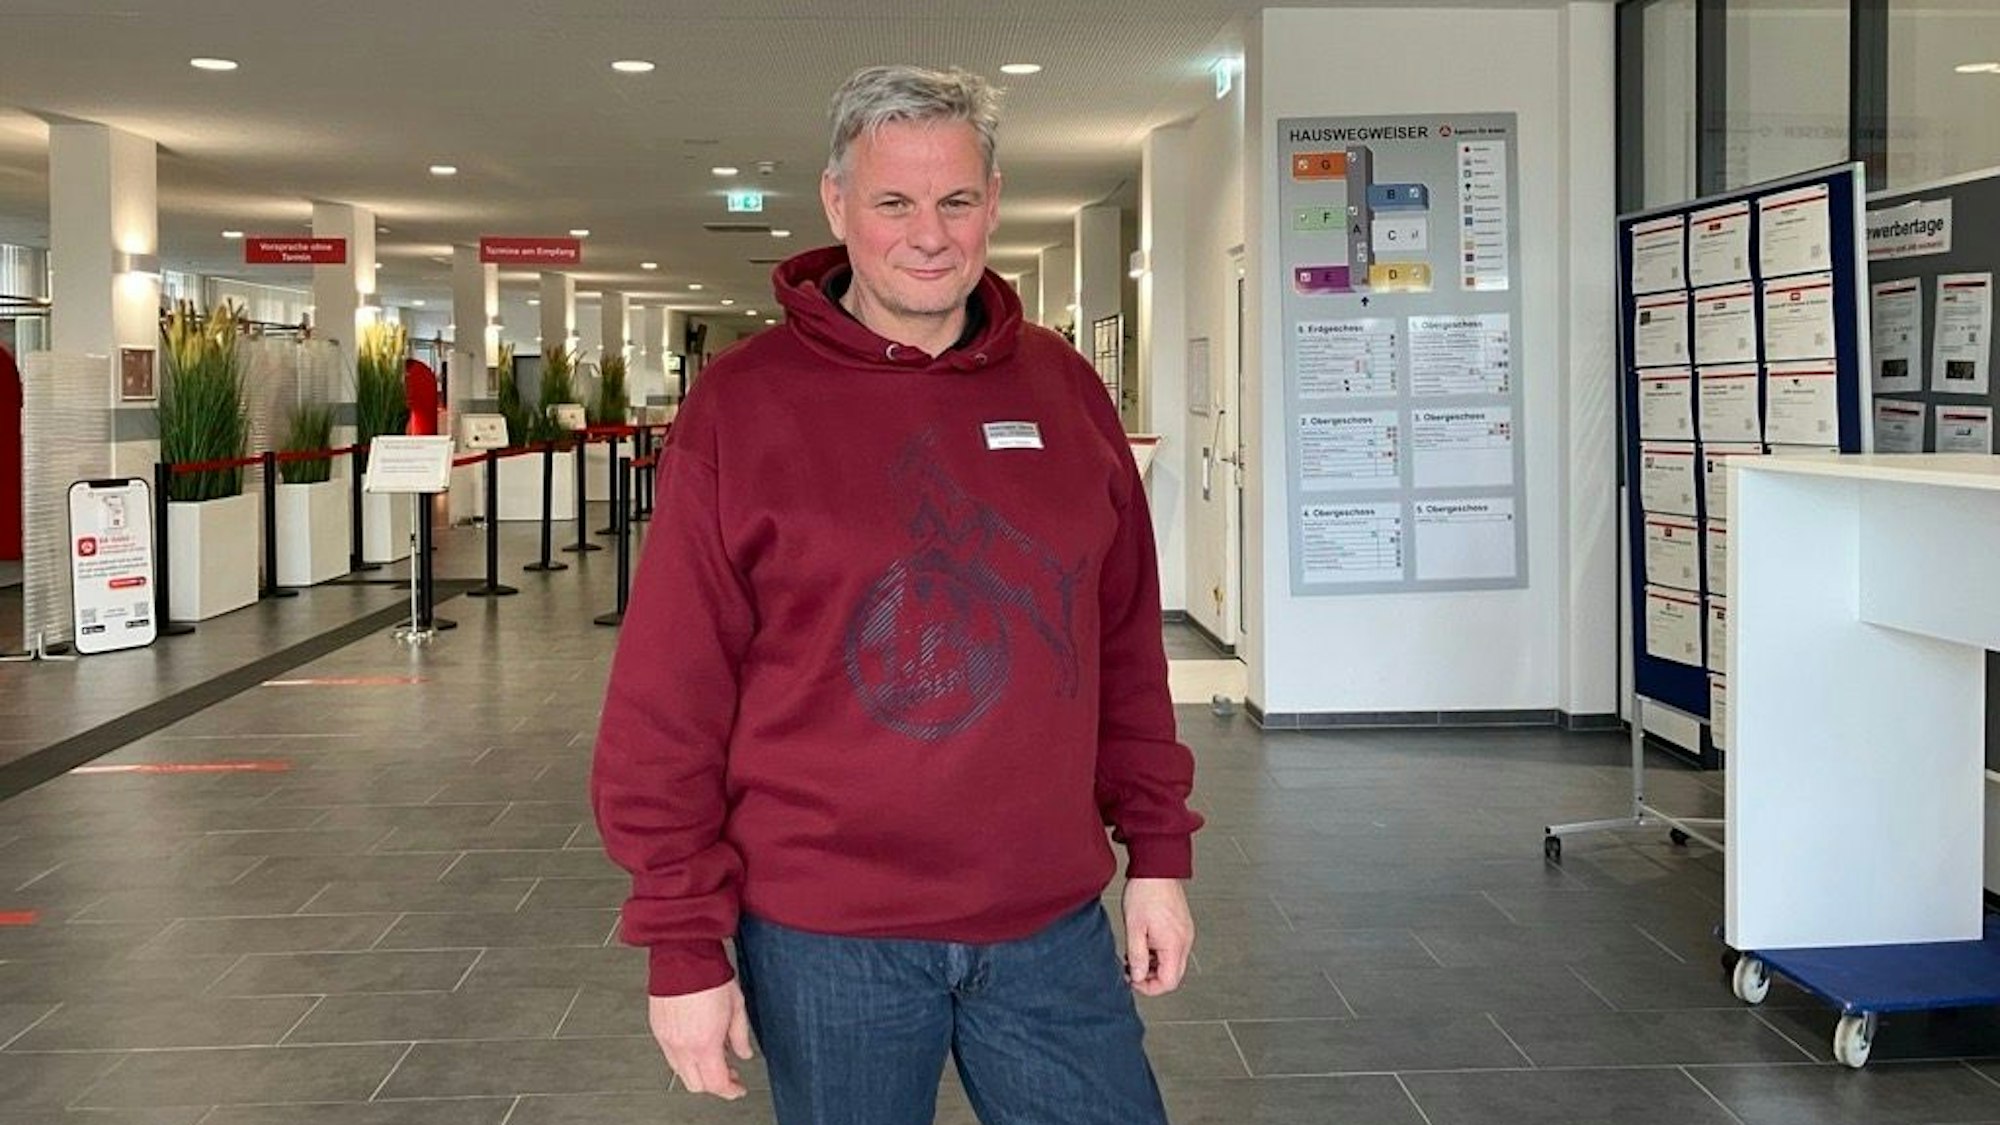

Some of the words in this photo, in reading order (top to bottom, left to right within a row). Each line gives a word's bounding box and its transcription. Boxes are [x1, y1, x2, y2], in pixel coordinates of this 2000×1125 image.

[1289, 126, 1429, 141] HAUSWEGWEISER
[1321, 160, 1331, 170] G
[1387, 189, 1396, 199] B
[1324, 212, 1331, 223] F
[1353, 223, 1361, 235] A
[1388, 230, 1397, 241] C
[259, 243, 309, 252] Vorsprache
[310, 243, 333, 251] ohne
[485, 246, 519, 255] Termine
[536, 247, 575, 258] Empfang
[282, 253, 312, 261] Termin
[1324, 271, 1332, 281] E
[1389, 269, 1397, 280] D
[1307, 324, 1364, 334] Erdgeschoss
[1421, 320, 1483, 331] Obergeschoss
[1310, 416, 1373, 426] Obergeschoss
[1423, 412, 1485, 422] Obergeschoss
[1313, 509, 1376, 518] Obergeschoss
[1426, 504, 1488, 514] Obergeschoss
